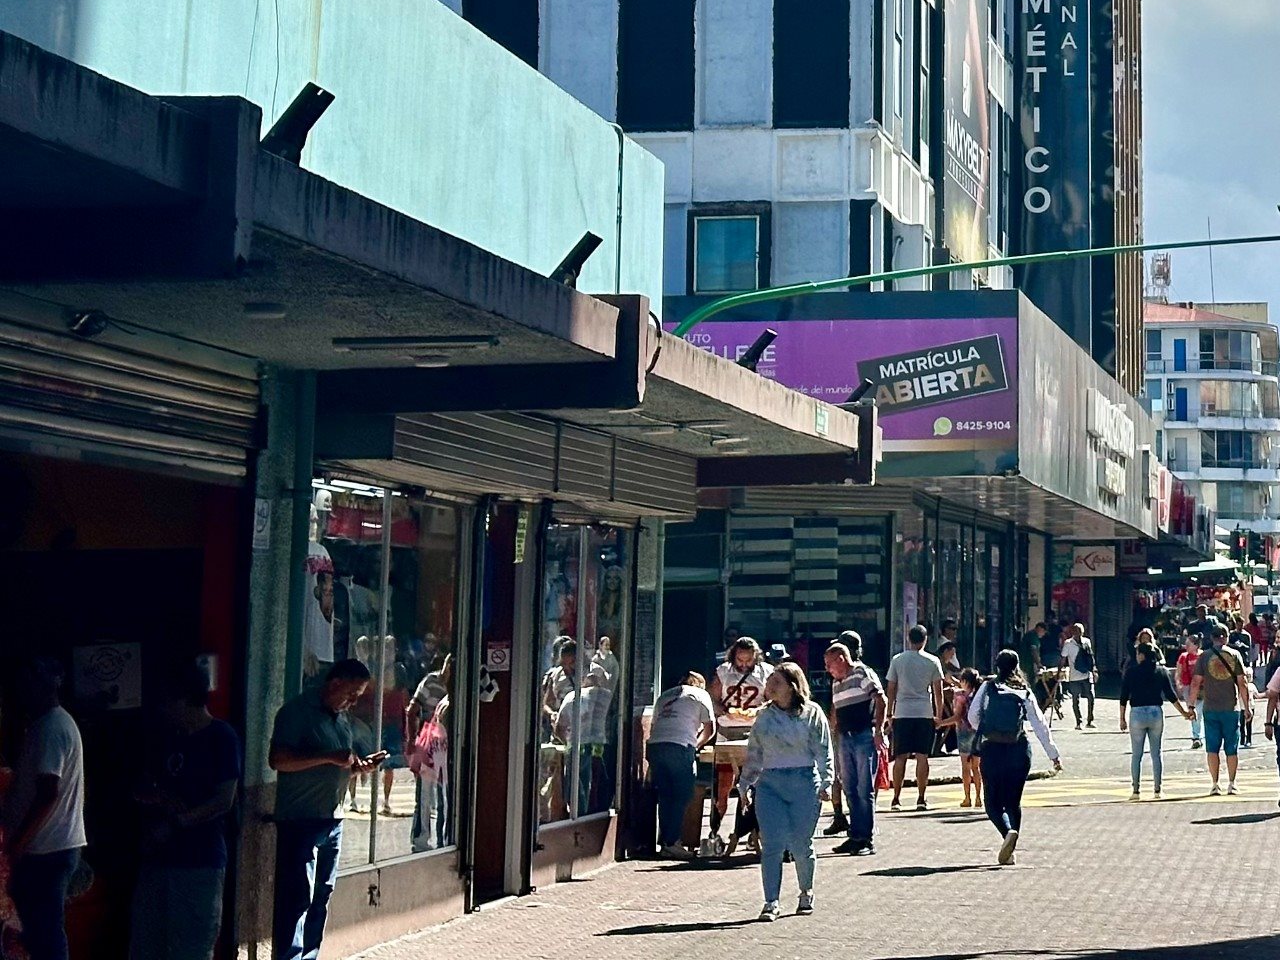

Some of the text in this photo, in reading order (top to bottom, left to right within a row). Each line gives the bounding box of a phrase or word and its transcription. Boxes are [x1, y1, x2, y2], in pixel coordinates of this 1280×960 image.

[879, 346, 981, 379] MATRÍCULA
[826, 385, 853, 394] mundo
[876, 363, 996, 407] ABIERTA
[956, 420, 1011, 431] 8425-9104
